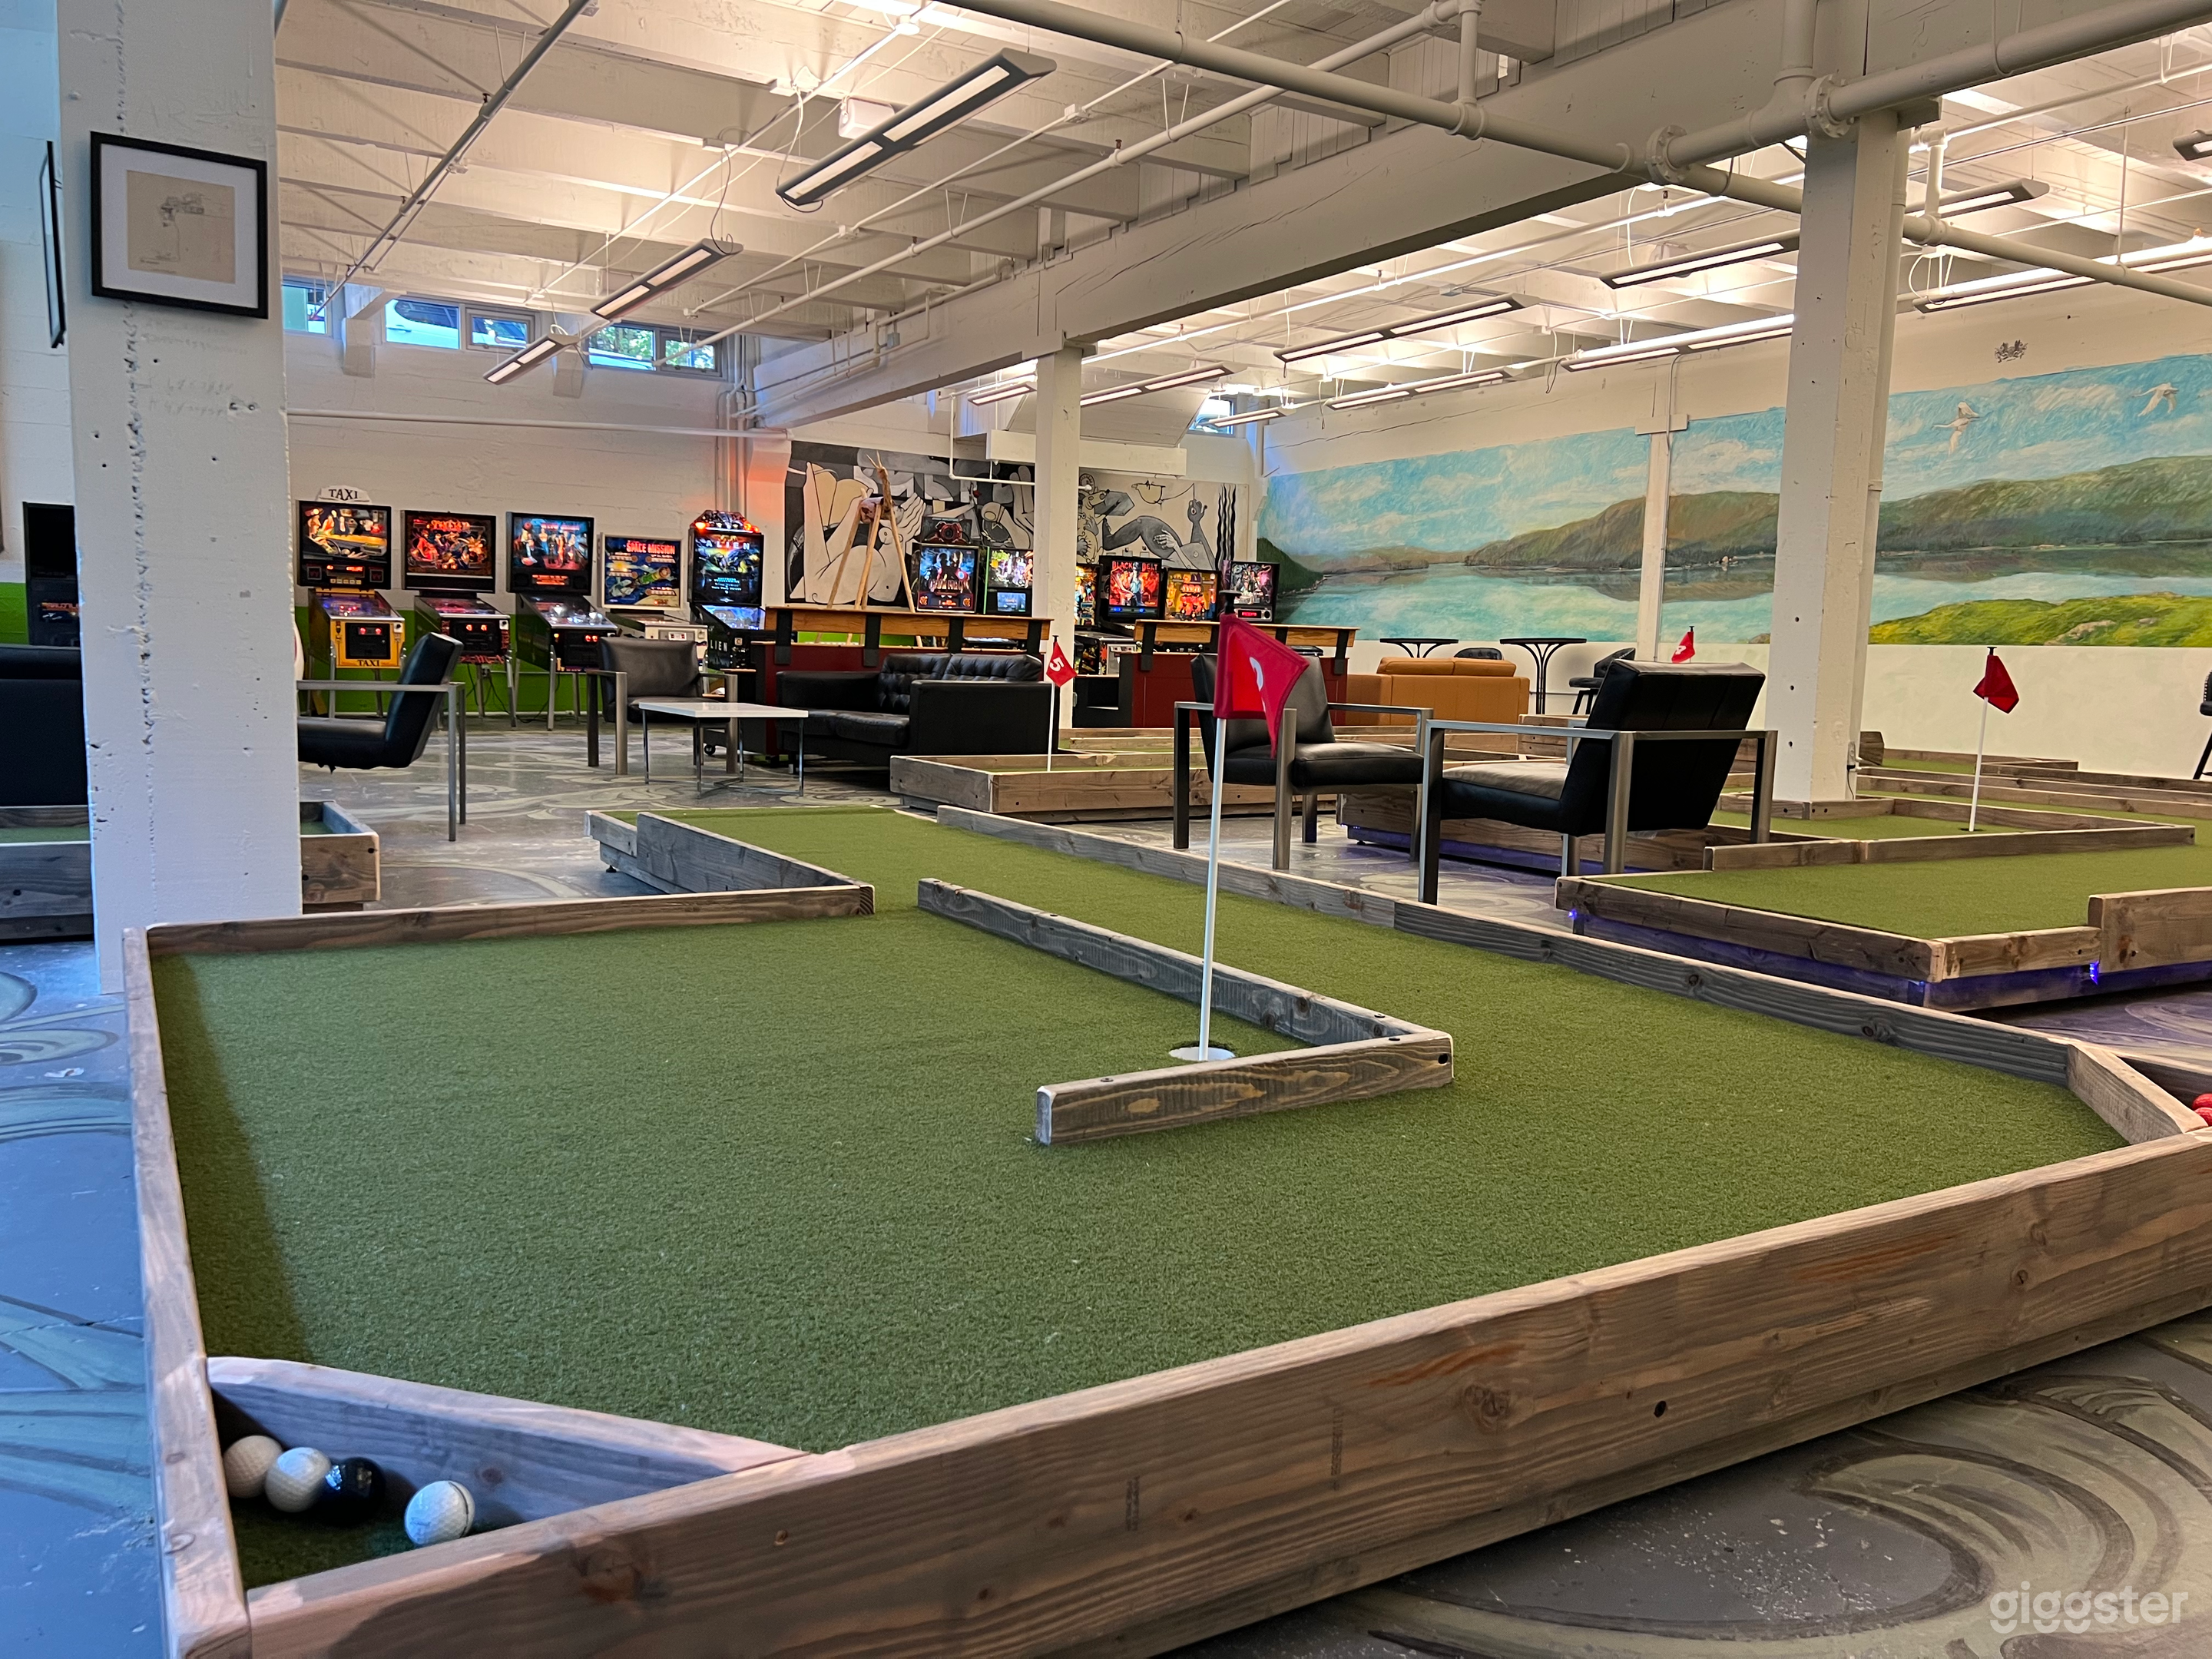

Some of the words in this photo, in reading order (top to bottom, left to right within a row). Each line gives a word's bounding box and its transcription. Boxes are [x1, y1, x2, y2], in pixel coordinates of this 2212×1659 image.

[329, 488, 358, 501] TAXI
[626, 541, 647, 553] SPACE
[647, 543, 676, 555] MISSION
[706, 539, 750, 550] ALIEN
[1111, 561, 1134, 571] BLACK
[1141, 563, 1158, 572] BELT
[710, 639, 728, 652] LIEN
[1049, 657, 1065, 672] 5
